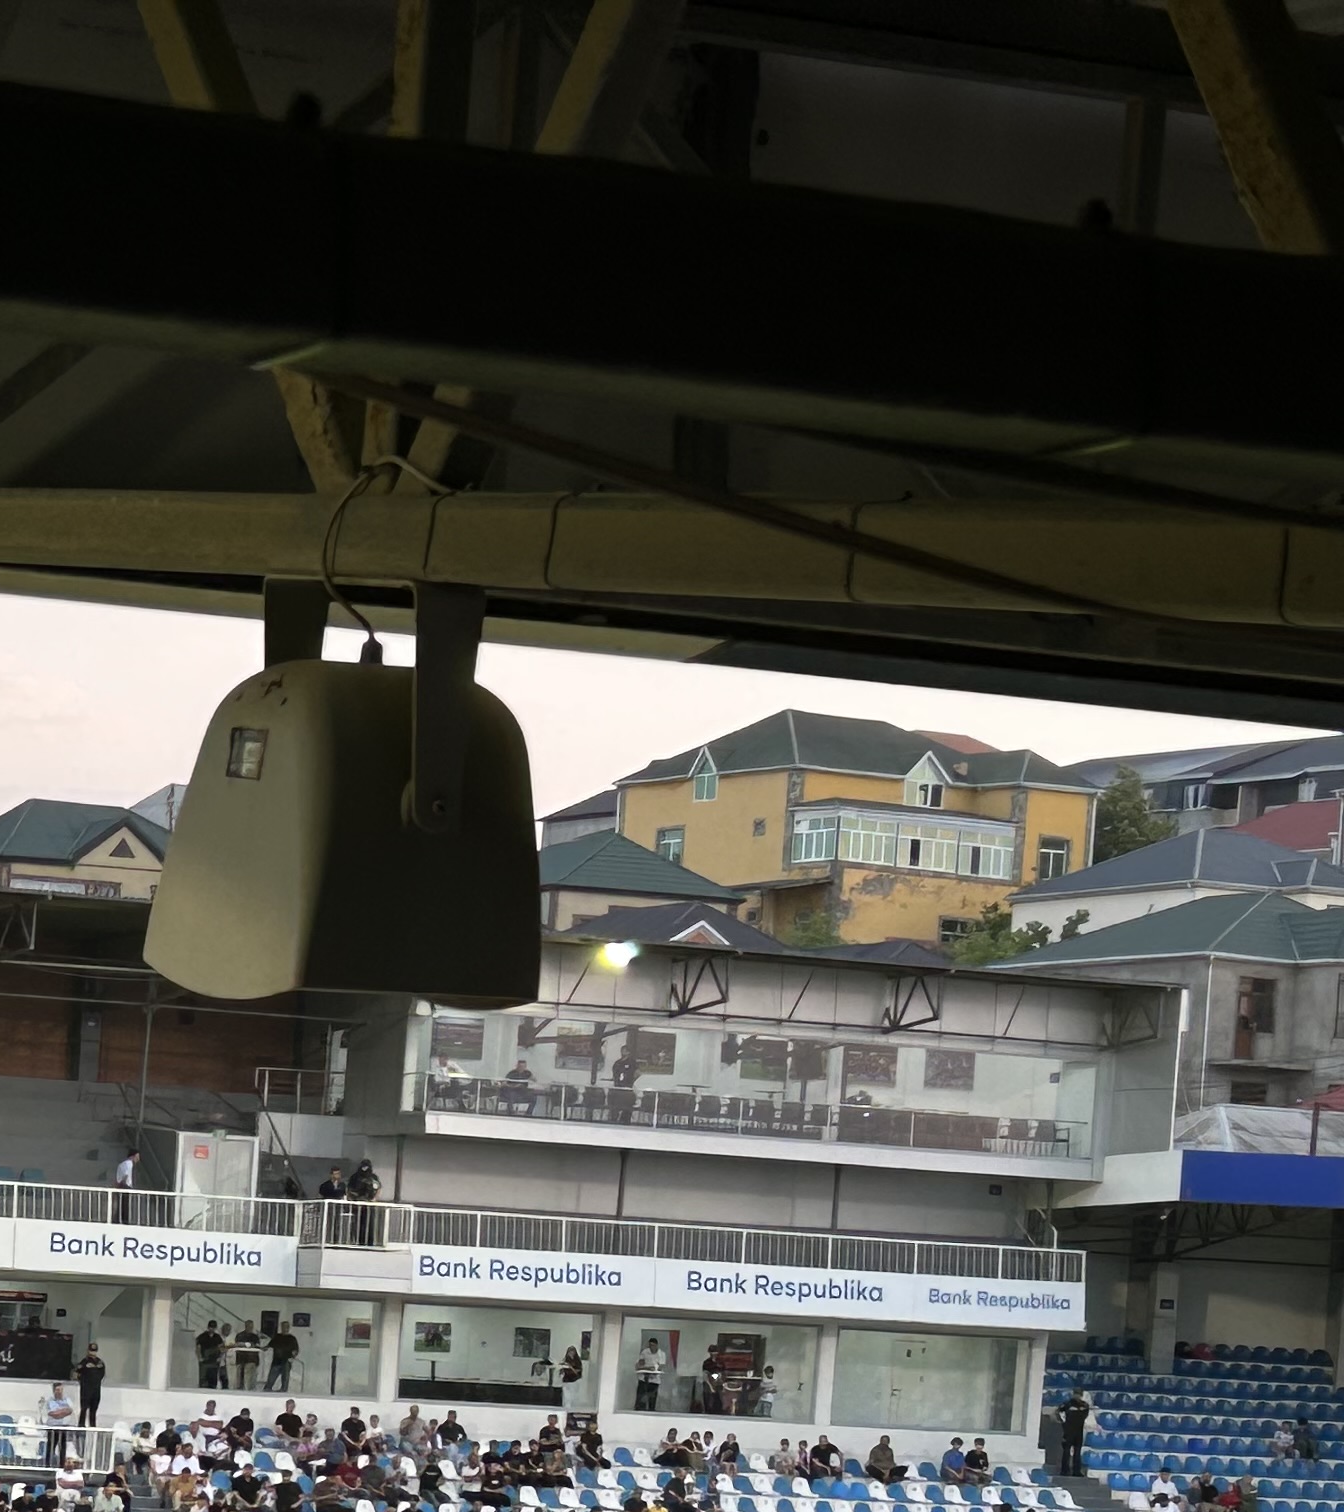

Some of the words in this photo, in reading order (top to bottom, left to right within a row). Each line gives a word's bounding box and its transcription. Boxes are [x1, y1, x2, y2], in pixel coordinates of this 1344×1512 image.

[50, 1232, 115, 1257] Bank
[122, 1236, 262, 1267] Respublika
[419, 1255, 481, 1279] Bank
[489, 1258, 622, 1289] Respublika
[686, 1270, 747, 1295] Bank
[754, 1274, 883, 1303] Respublika
[928, 1288, 972, 1306] Bank
[976, 1290, 1071, 1313] Respublika
